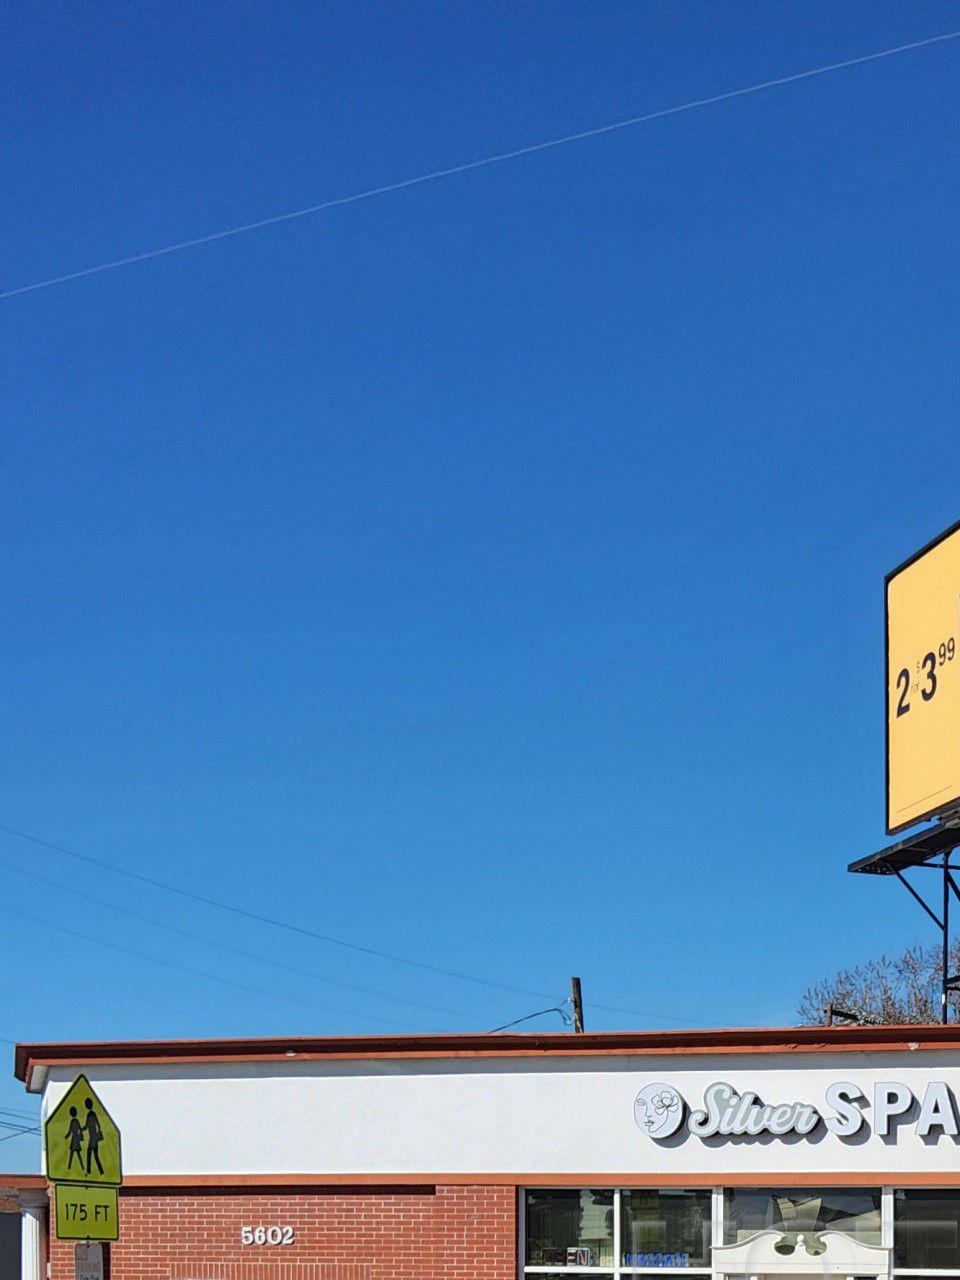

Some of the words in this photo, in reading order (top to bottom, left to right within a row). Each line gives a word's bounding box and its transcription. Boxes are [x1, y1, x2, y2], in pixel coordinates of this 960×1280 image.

[896, 668, 911, 719] 2
[688, 1081, 821, 1137] Silver
[824, 1081, 960, 1136] SPA
[65, 1203, 88, 1222] 175
[94, 1204, 110, 1222] FT
[241, 1226, 291, 1246] 5602
